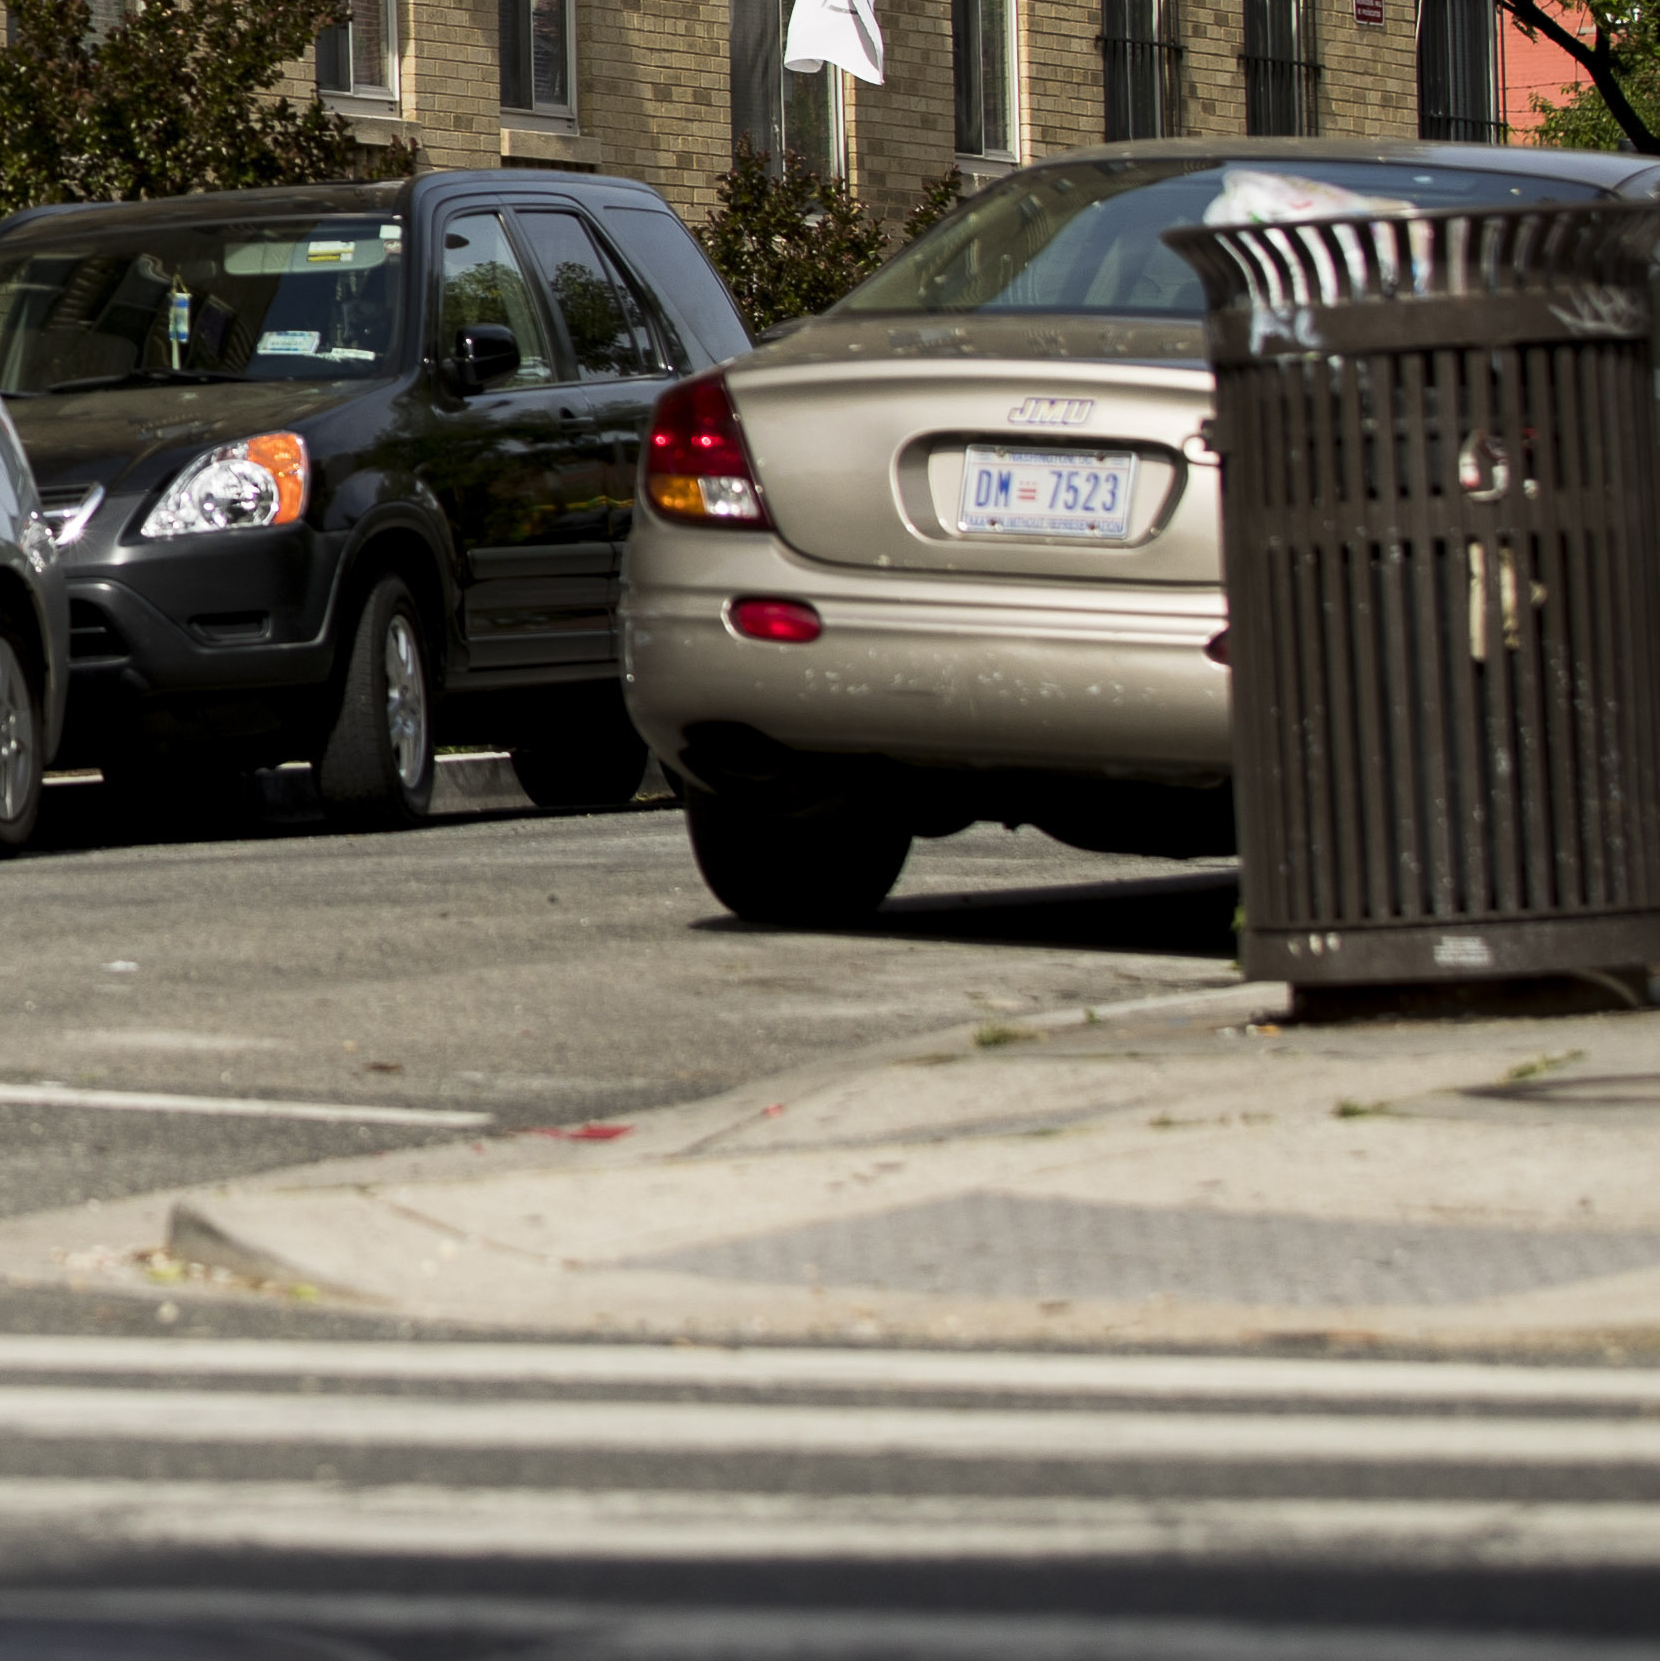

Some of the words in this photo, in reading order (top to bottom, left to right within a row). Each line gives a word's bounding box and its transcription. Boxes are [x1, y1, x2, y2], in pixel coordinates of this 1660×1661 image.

[1008, 397, 1095, 424] JMU
[974, 469, 1013, 508] DM
[1047, 470, 1119, 512] 7523
